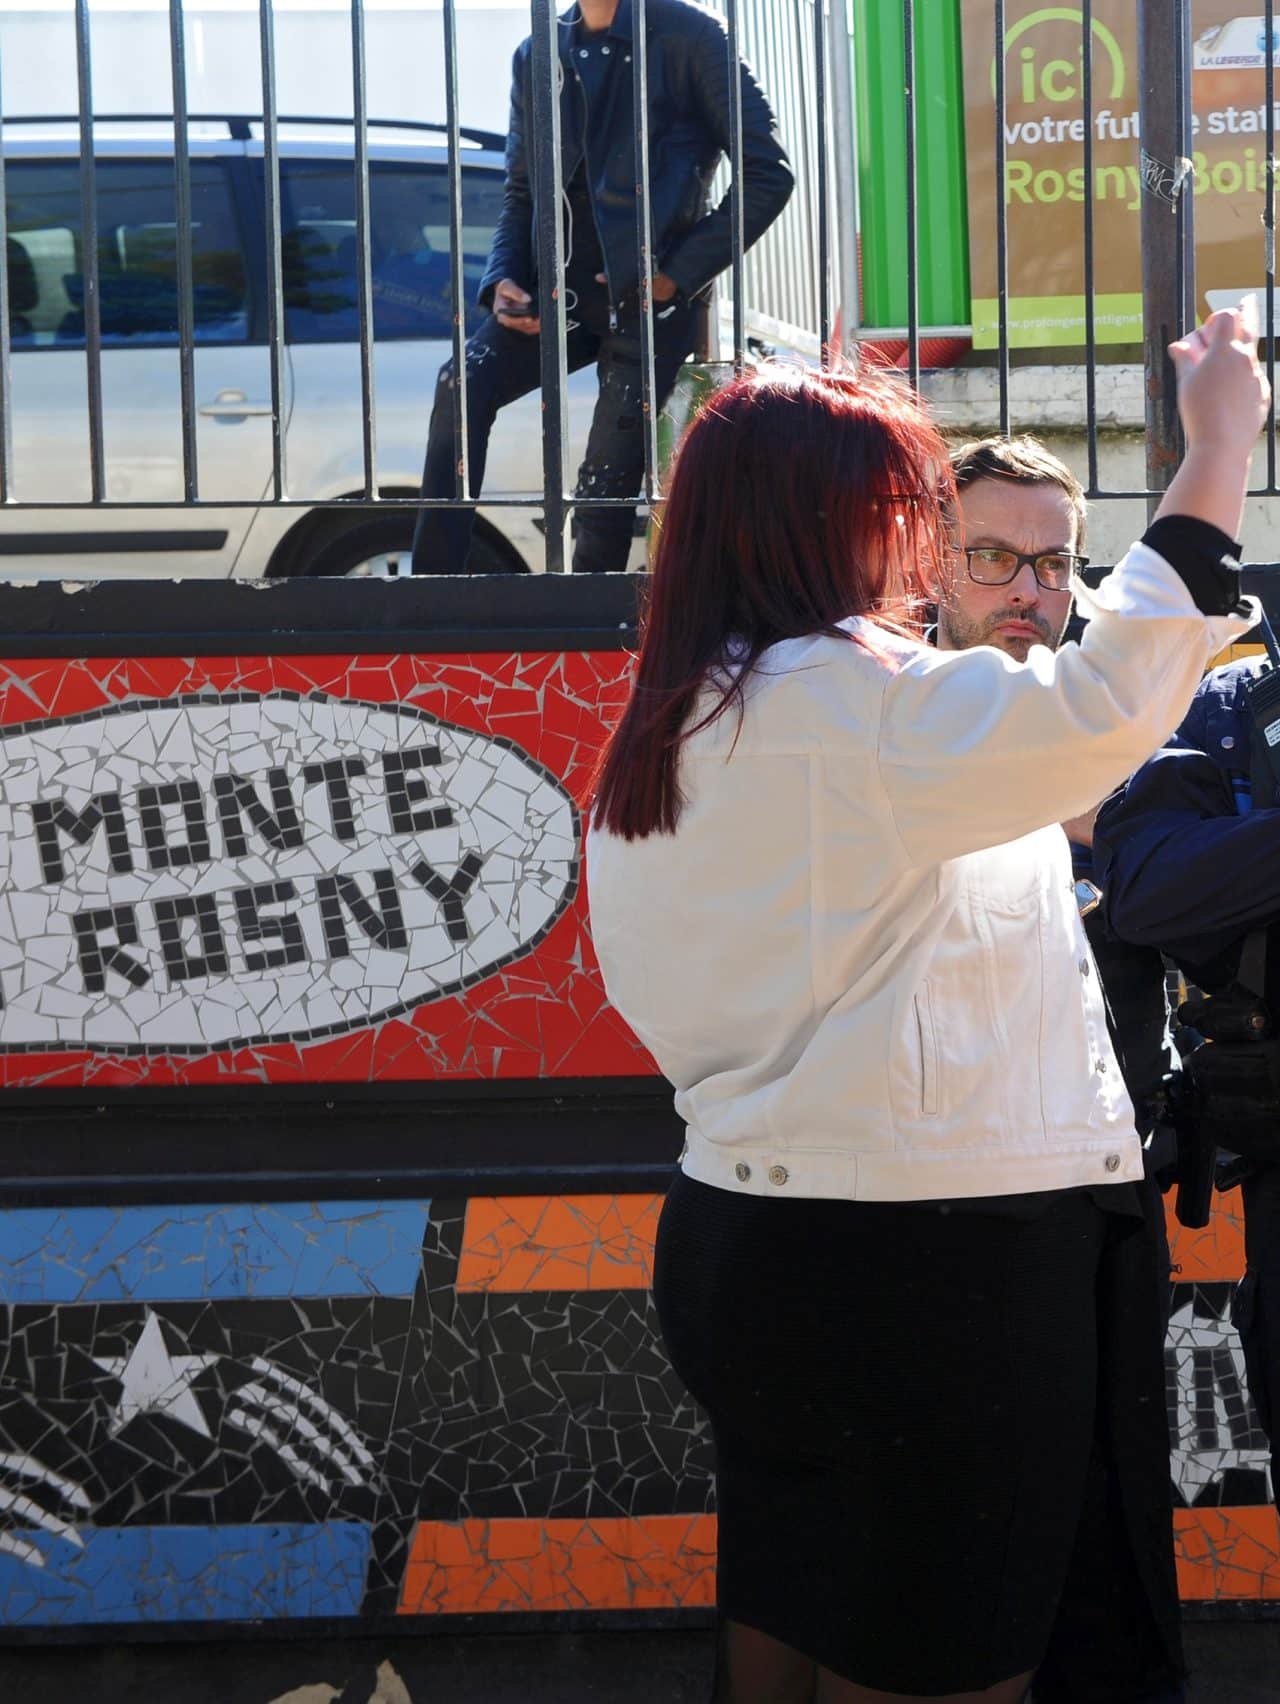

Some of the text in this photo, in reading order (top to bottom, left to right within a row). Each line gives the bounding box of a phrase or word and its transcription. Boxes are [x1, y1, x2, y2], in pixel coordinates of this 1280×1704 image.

[1003, 115, 1084, 145] votre
[1005, 160, 1141, 211] Rosny
[32, 746, 453, 883] MONTE
[72, 853, 482, 992] ROSNY
